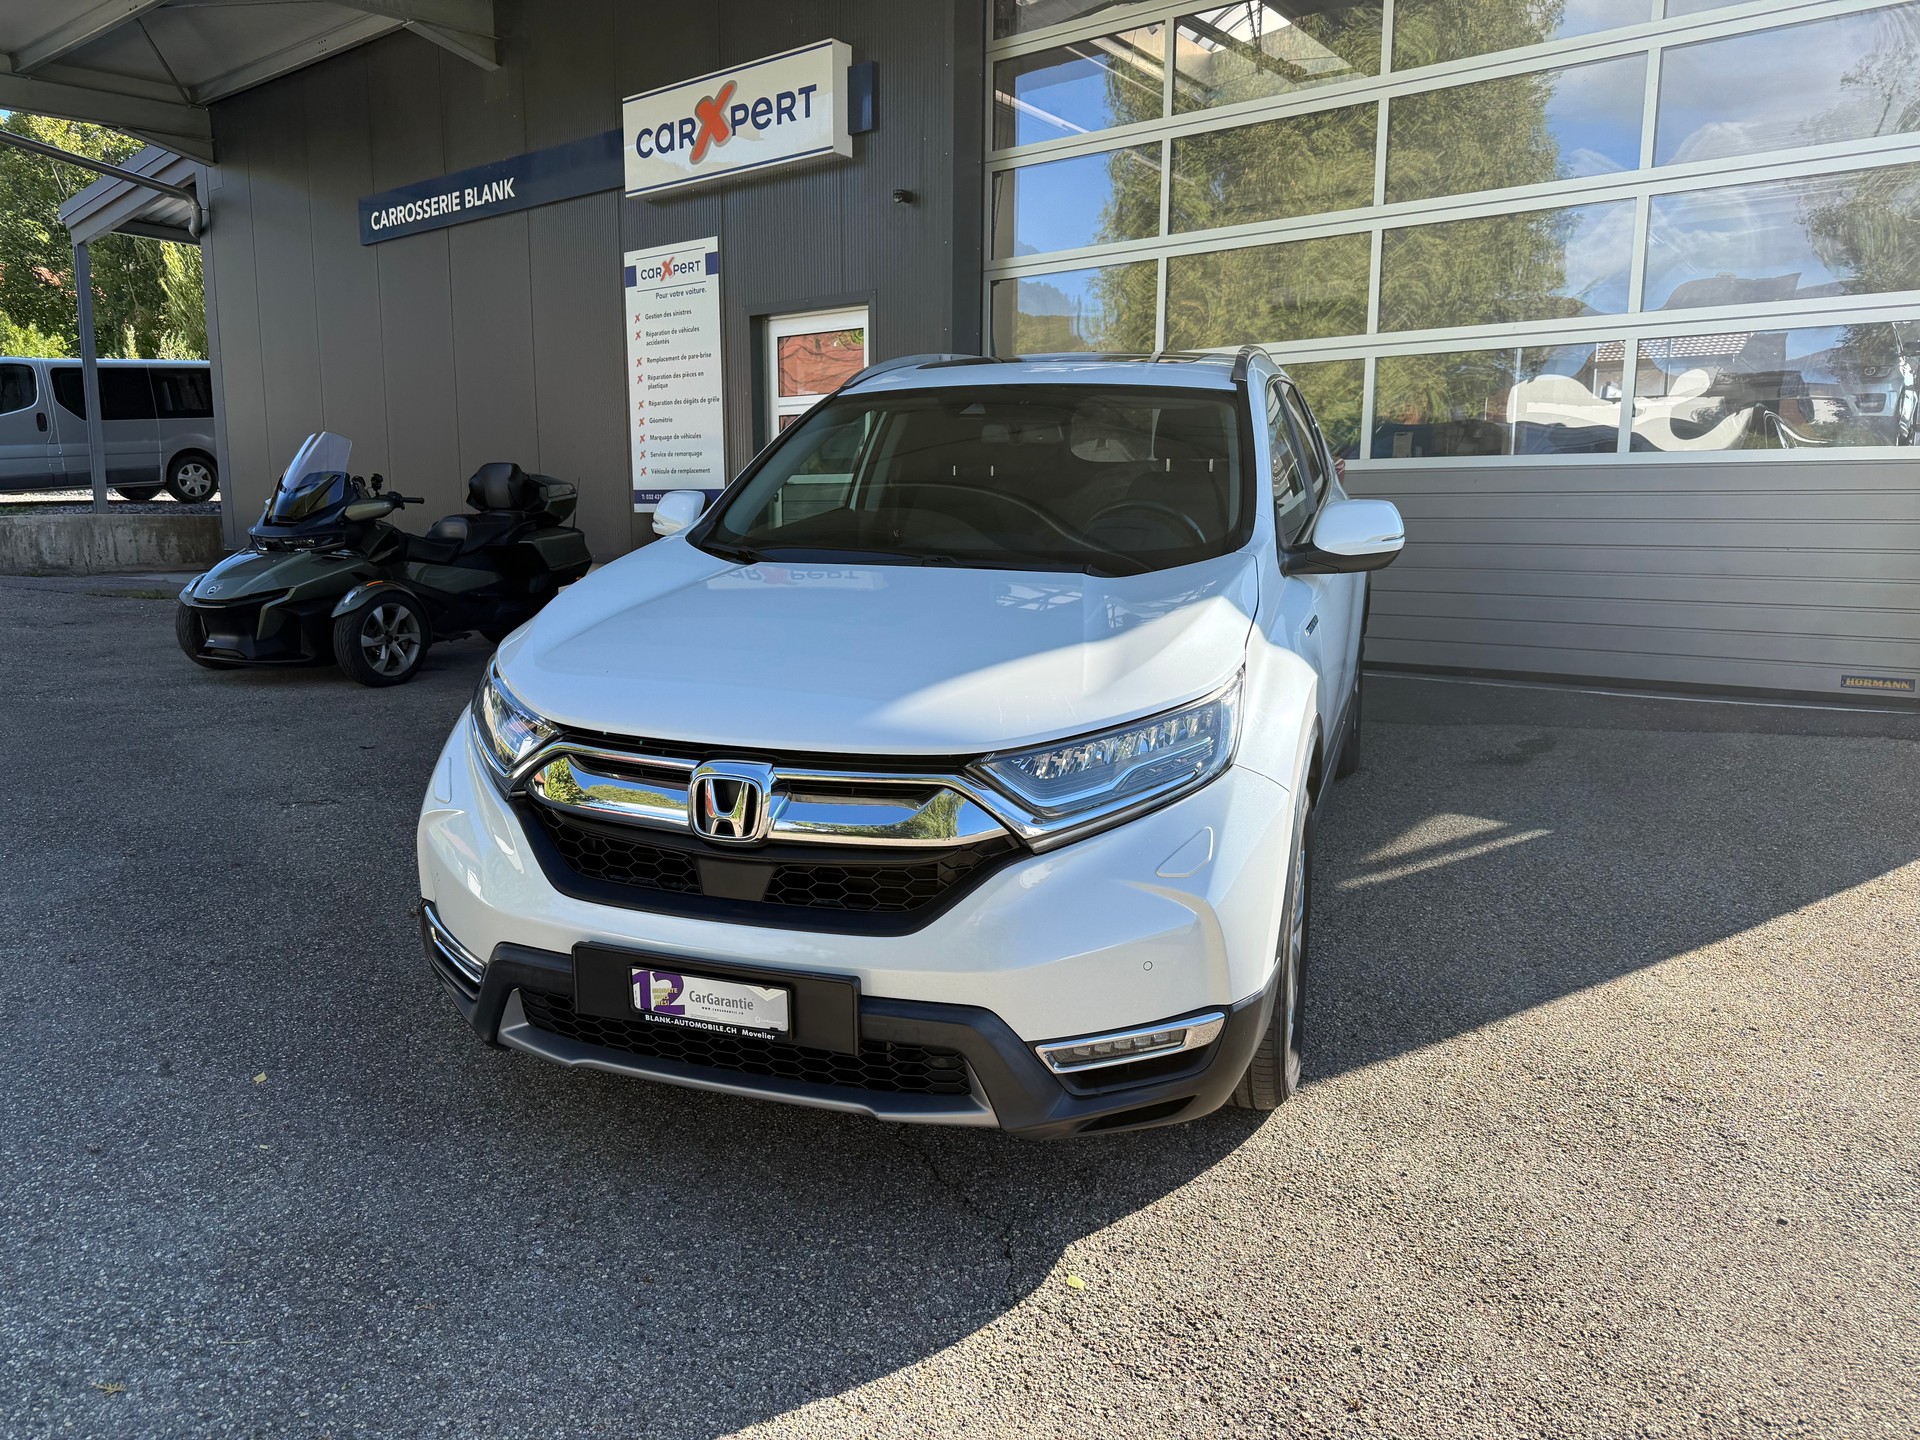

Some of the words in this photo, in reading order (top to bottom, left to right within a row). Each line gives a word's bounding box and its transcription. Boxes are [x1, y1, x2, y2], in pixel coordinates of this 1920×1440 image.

[371, 191, 460, 230] CARROSSERIE
[464, 177, 515, 209] BLANK
[670, 290, 684, 298] votre
[685, 287, 707, 295] voiture.
[646, 330, 670, 338] Réparation
[678, 325, 699, 333] véhicules
[646, 338, 669, 346] accidentés
[647, 356, 680, 364] Remplacement
[688, 352, 711, 361] pare-brise
[682, 371, 697, 379] pièces
[650, 434, 672, 442] Marquage
[632, 970, 685, 1015] 12
[689, 990, 754, 1011] CarGarantie
[645, 1014, 737, 1035] BLANK-AUTOMOBILE.CH
[741, 1028, 776, 1041] Movelier
